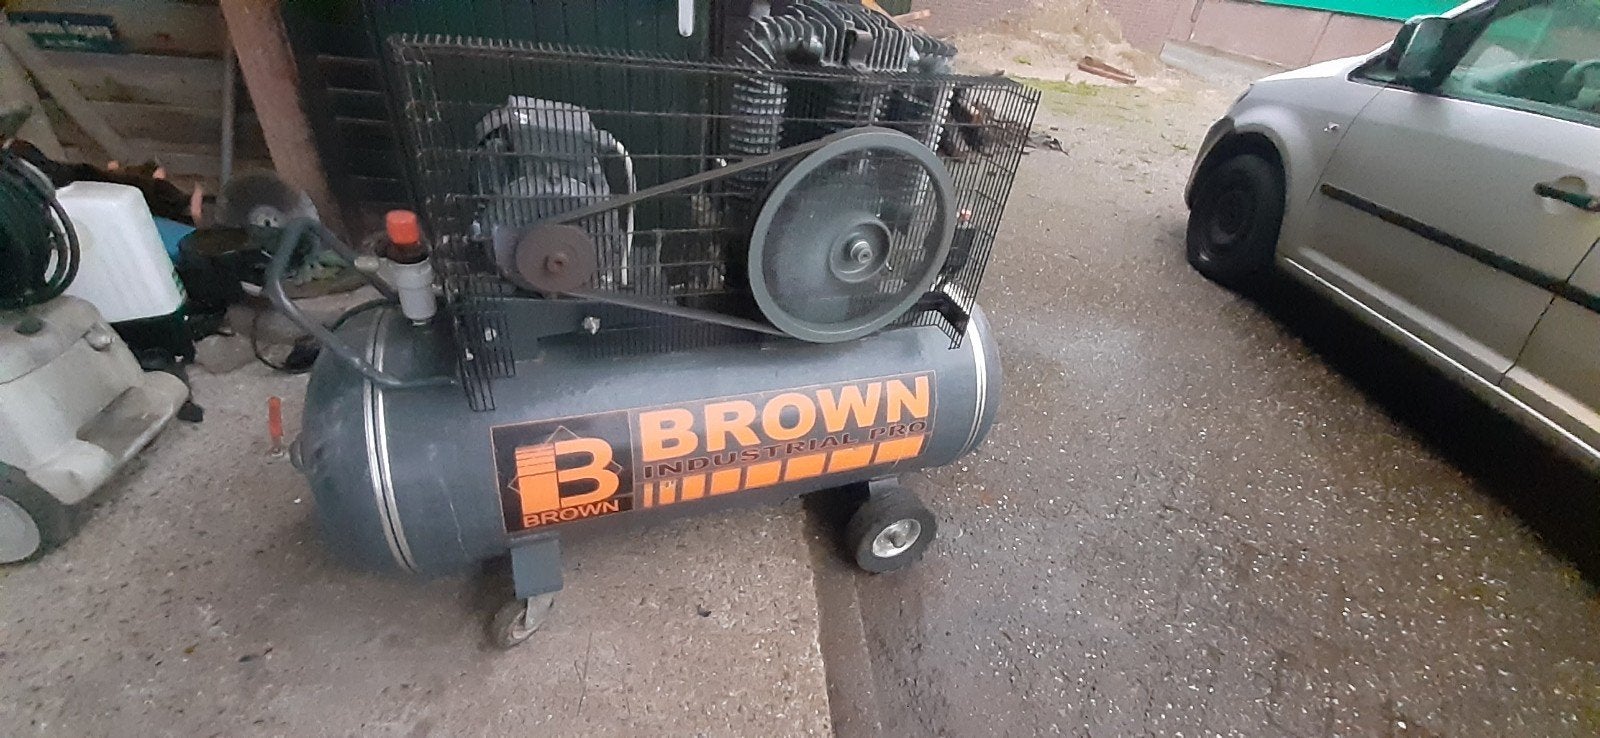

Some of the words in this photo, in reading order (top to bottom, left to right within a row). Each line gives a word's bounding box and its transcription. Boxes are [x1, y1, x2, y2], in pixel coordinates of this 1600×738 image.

[639, 376, 930, 462] BROWN
[644, 433, 857, 478] INDUSTRIAL
[868, 420, 927, 440] PRO
[522, 499, 619, 528] BROWN
